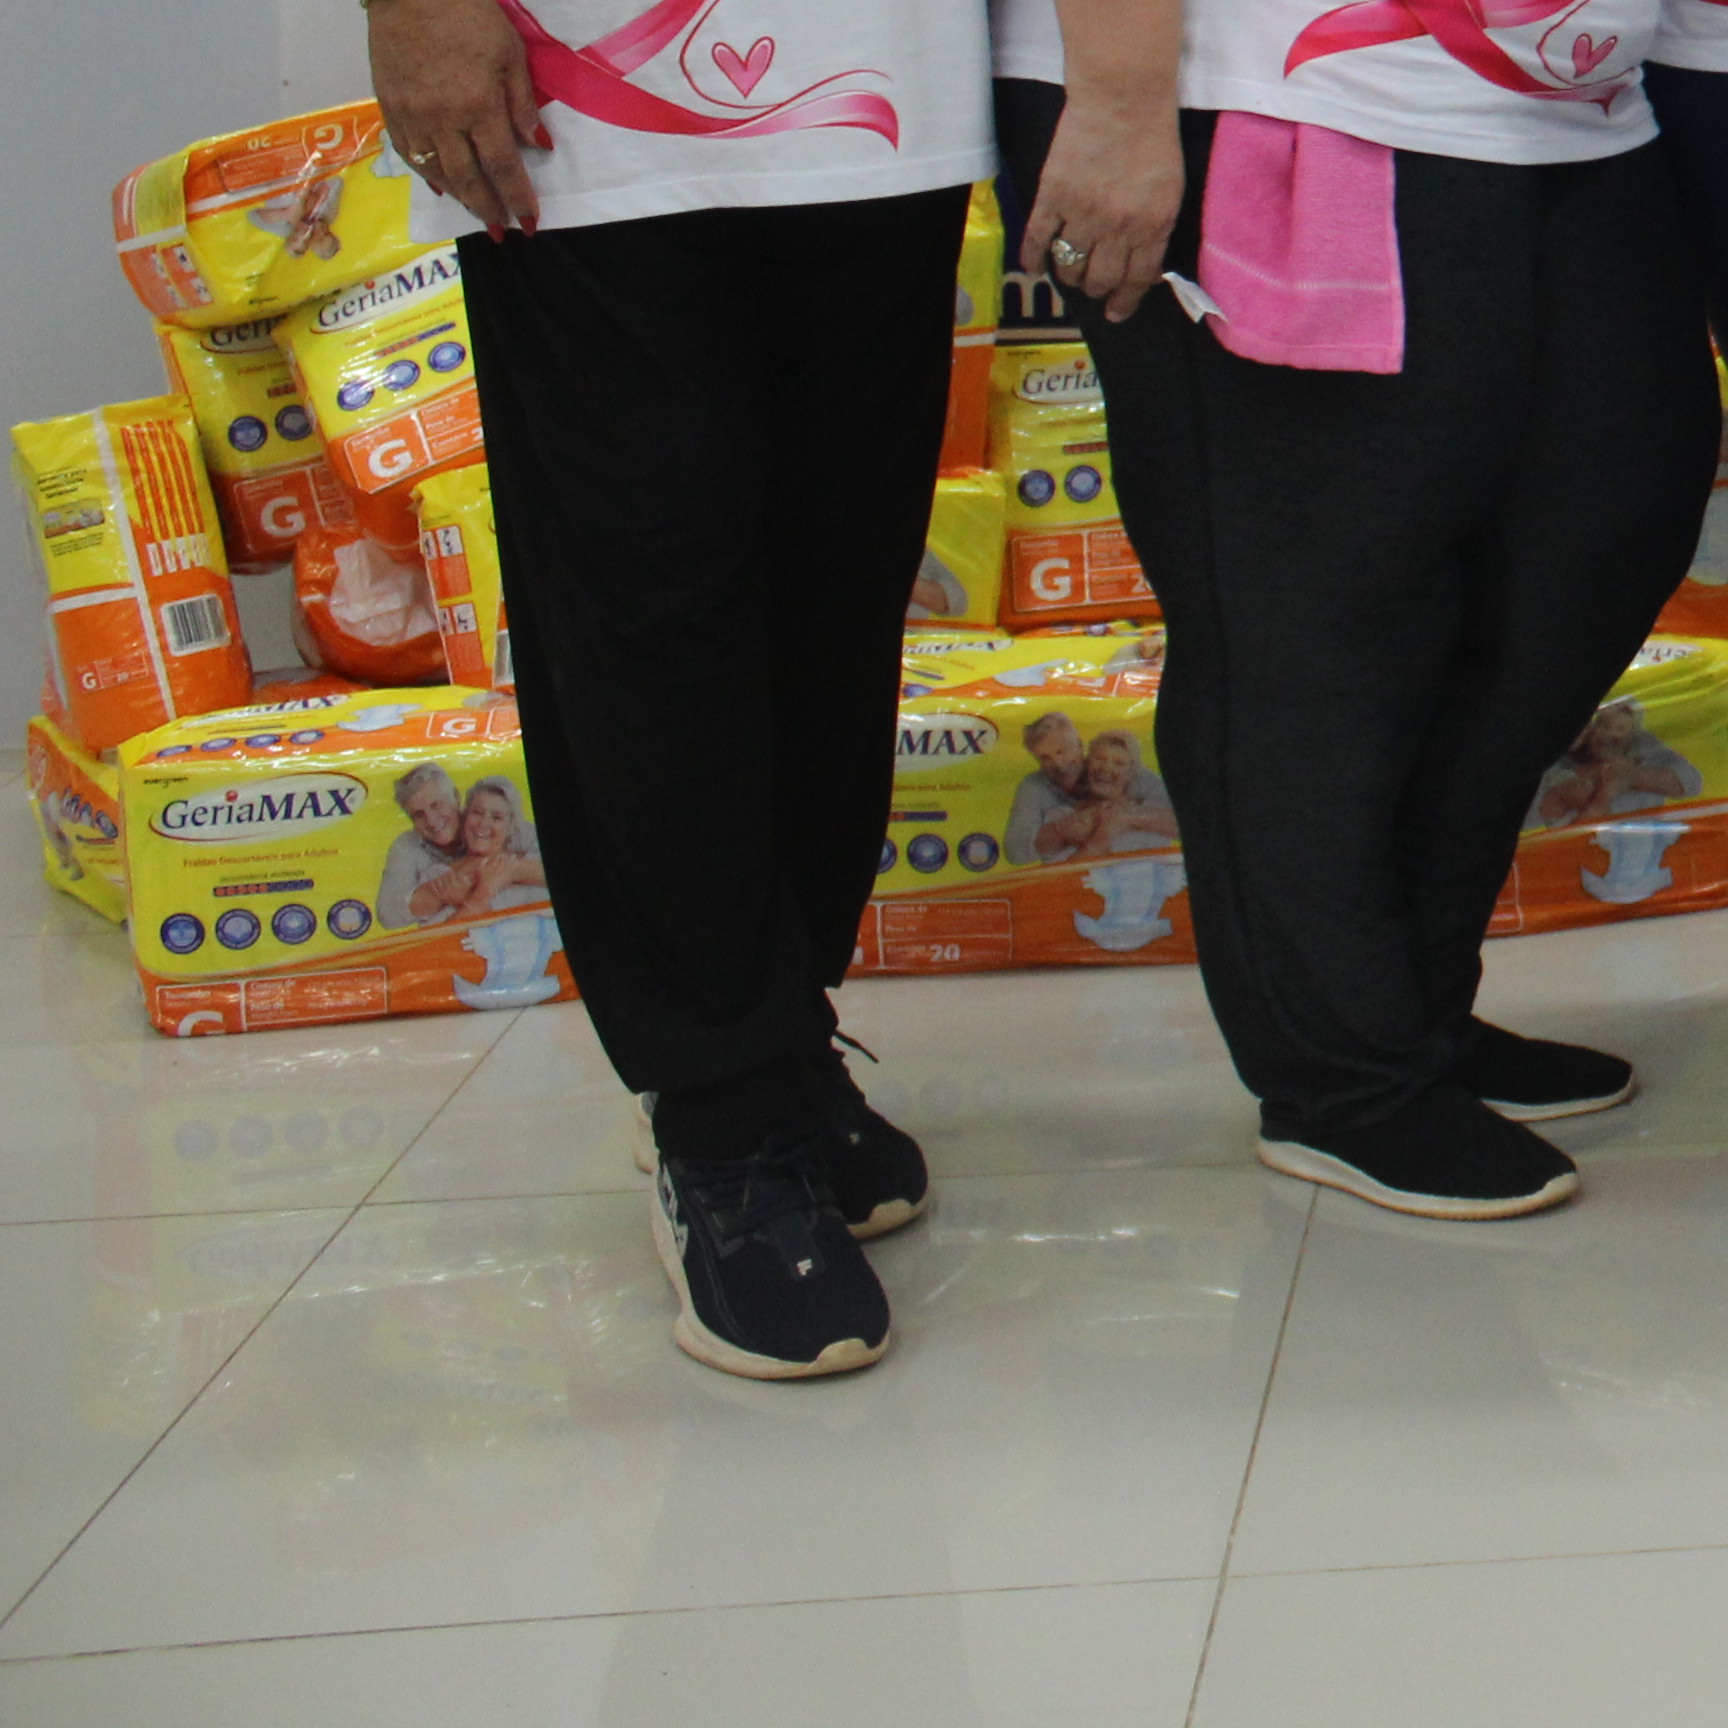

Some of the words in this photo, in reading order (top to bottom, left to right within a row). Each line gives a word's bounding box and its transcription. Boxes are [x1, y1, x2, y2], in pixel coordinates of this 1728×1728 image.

[1022, 360, 1101, 395] Geria
[367, 438, 414, 478] G
[260, 495, 307, 539] G
[1029, 558, 1072, 601] G
[160, 787, 356, 829] GeriaMAX
